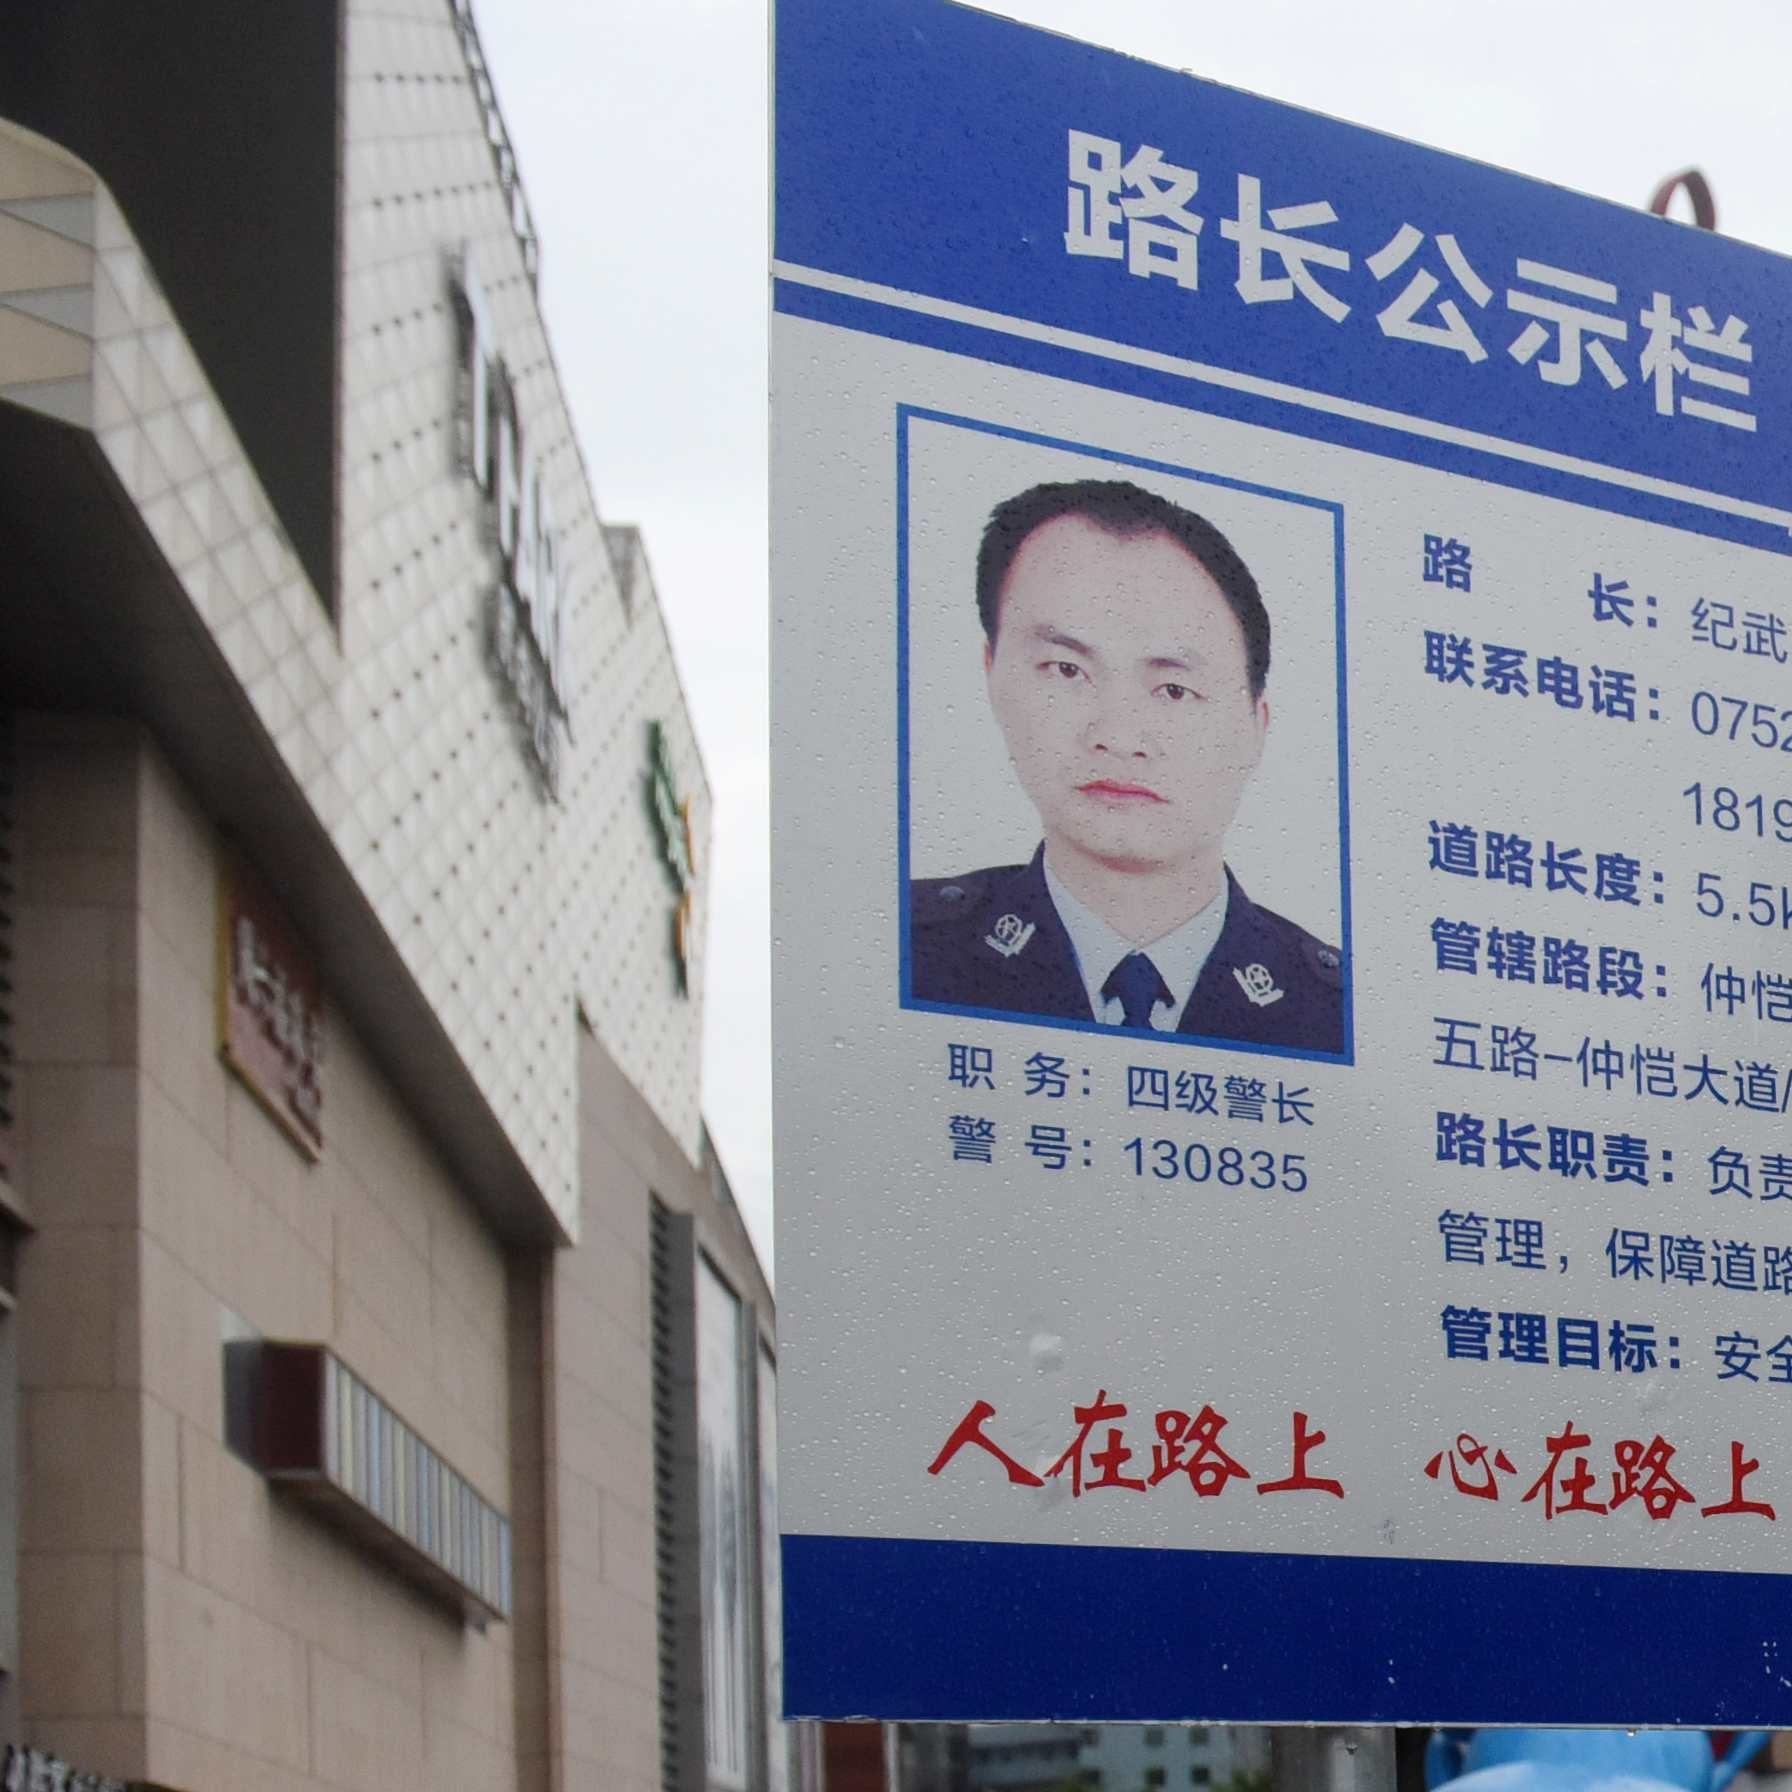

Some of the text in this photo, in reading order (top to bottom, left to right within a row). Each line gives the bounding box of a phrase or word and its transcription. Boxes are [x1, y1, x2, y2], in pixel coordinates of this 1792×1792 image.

[1064, 129, 1757, 432] 路长公示栏
[927, 1390, 1345, 1498] 人在路上
[1424, 1422, 1777, 1521] 心在路上
